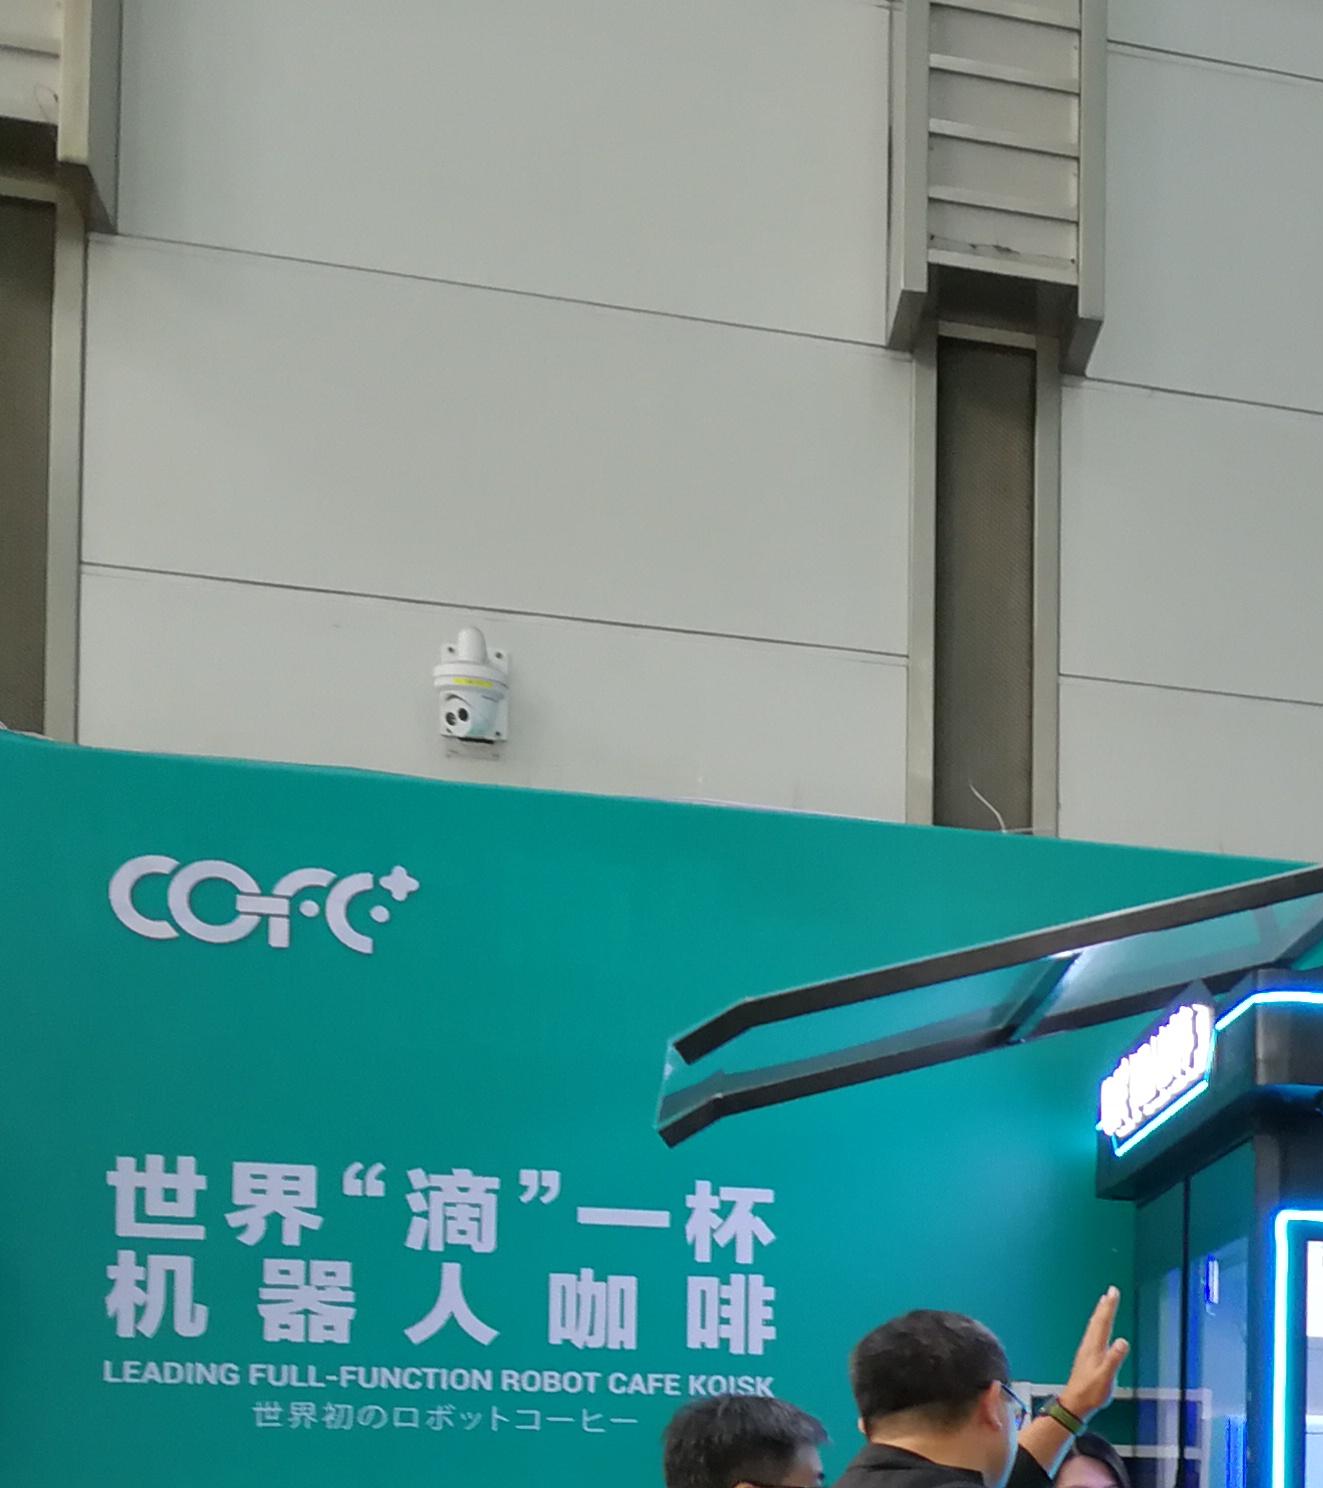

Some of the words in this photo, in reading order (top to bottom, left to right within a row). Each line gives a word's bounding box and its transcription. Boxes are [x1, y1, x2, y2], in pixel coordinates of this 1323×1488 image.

[105, 1250, 777, 1356] 机器人咖啡
[103, 1360, 240, 1386] LEADING
[249, 1363, 492, 1391] FULL-FUNCTION
[501, 1368, 600, 1393] ROBOT
[608, 1372, 681, 1396] CAFE
[688, 1375, 775, 1397] KOISK
[253, 1401, 639, 1433] 世界初のロボットコーヒー
